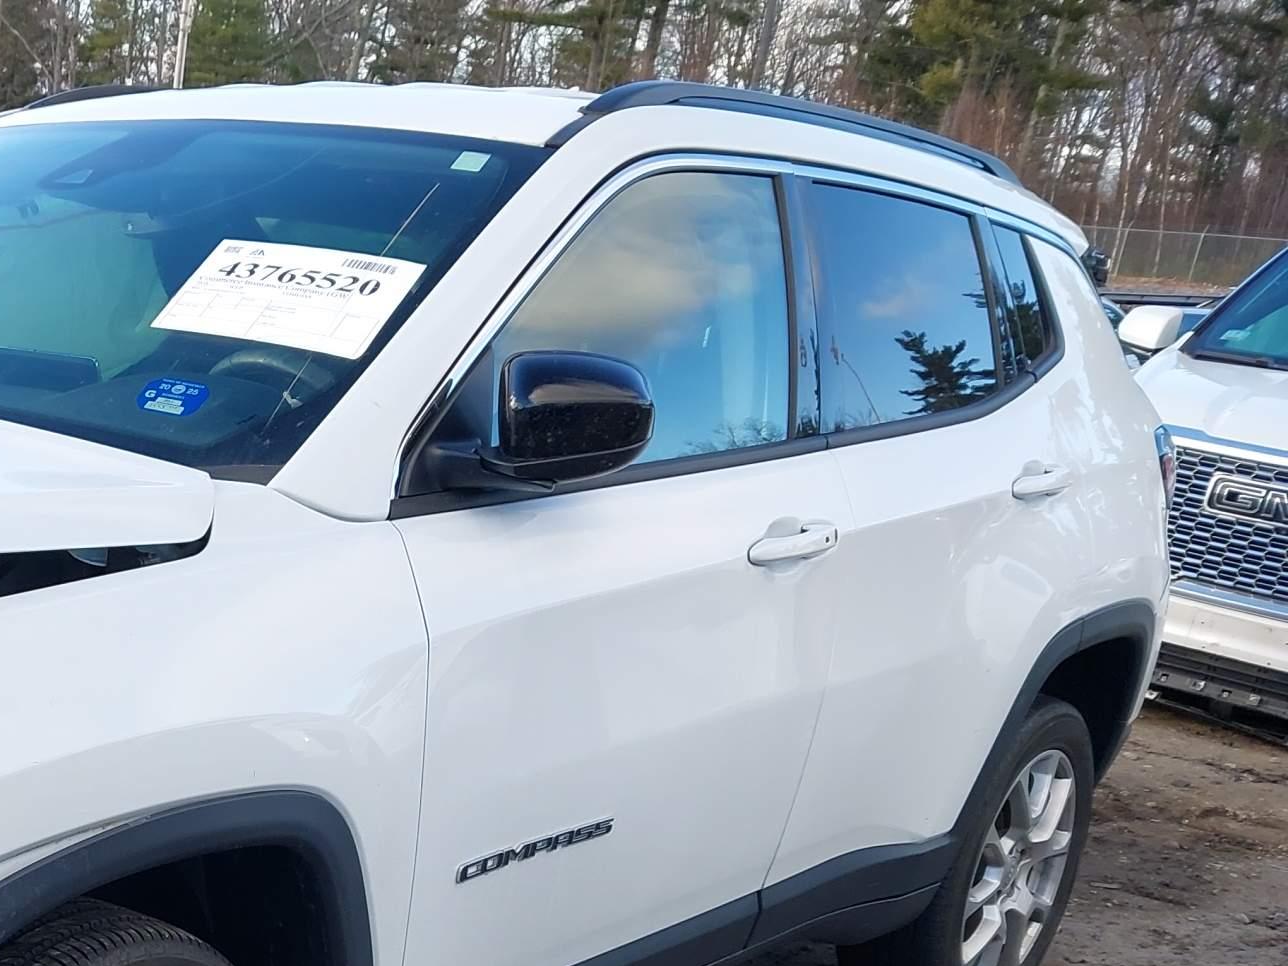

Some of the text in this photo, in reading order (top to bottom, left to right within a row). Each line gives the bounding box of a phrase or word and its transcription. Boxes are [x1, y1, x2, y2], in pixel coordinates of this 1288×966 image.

[218, 261, 381, 296] 43765520
[144, 389, 157, 398] G
[159, 383, 171, 391] 20
[455, 817, 615, 884] COMPASS
